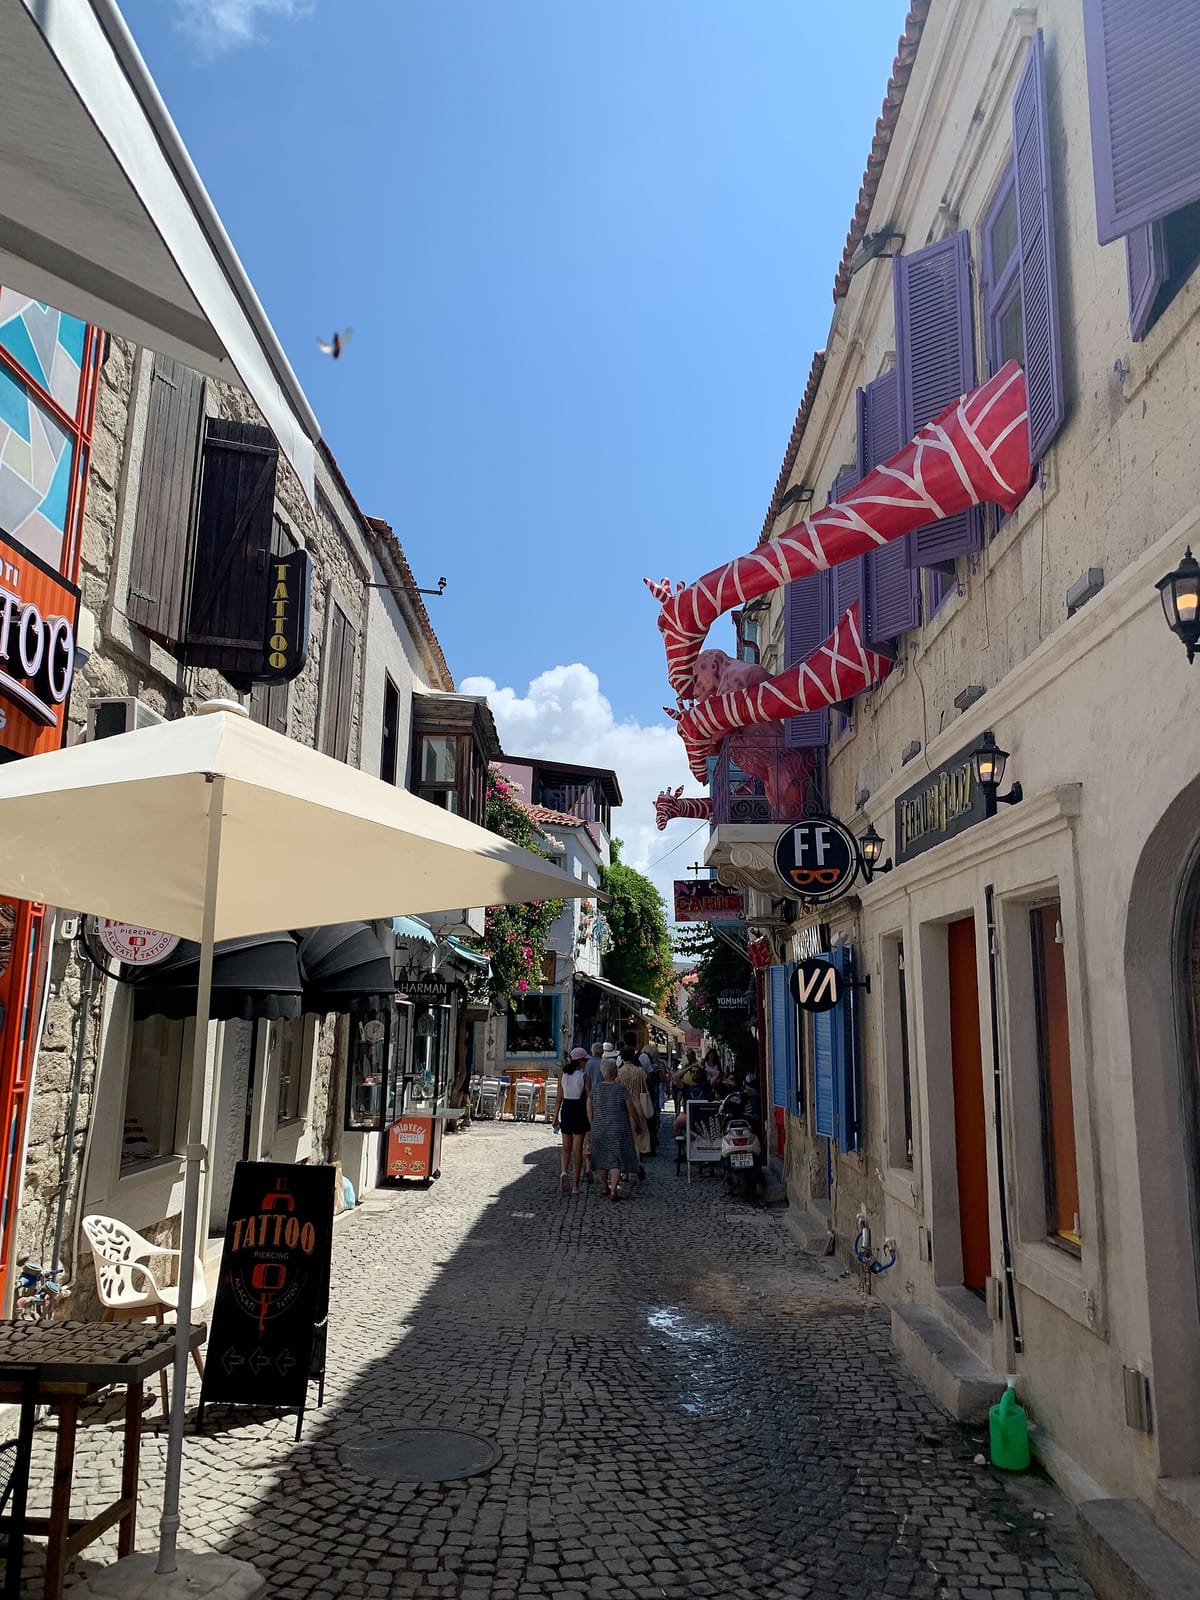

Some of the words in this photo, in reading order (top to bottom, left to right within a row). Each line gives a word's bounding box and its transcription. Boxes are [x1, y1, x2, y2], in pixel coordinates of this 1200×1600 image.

[269, 563, 291, 669] TATTOO
[793, 827, 831, 867] FF
[120, 928, 158, 936] PIERCING
[140, 937, 169, 959] TATTOO
[401, 983, 447, 994] HARMAN
[232, 1215, 316, 1255] TATTOO
[254, 1251, 290, 1260] PIERCING
[276, 1282, 299, 1310] TATTOO
